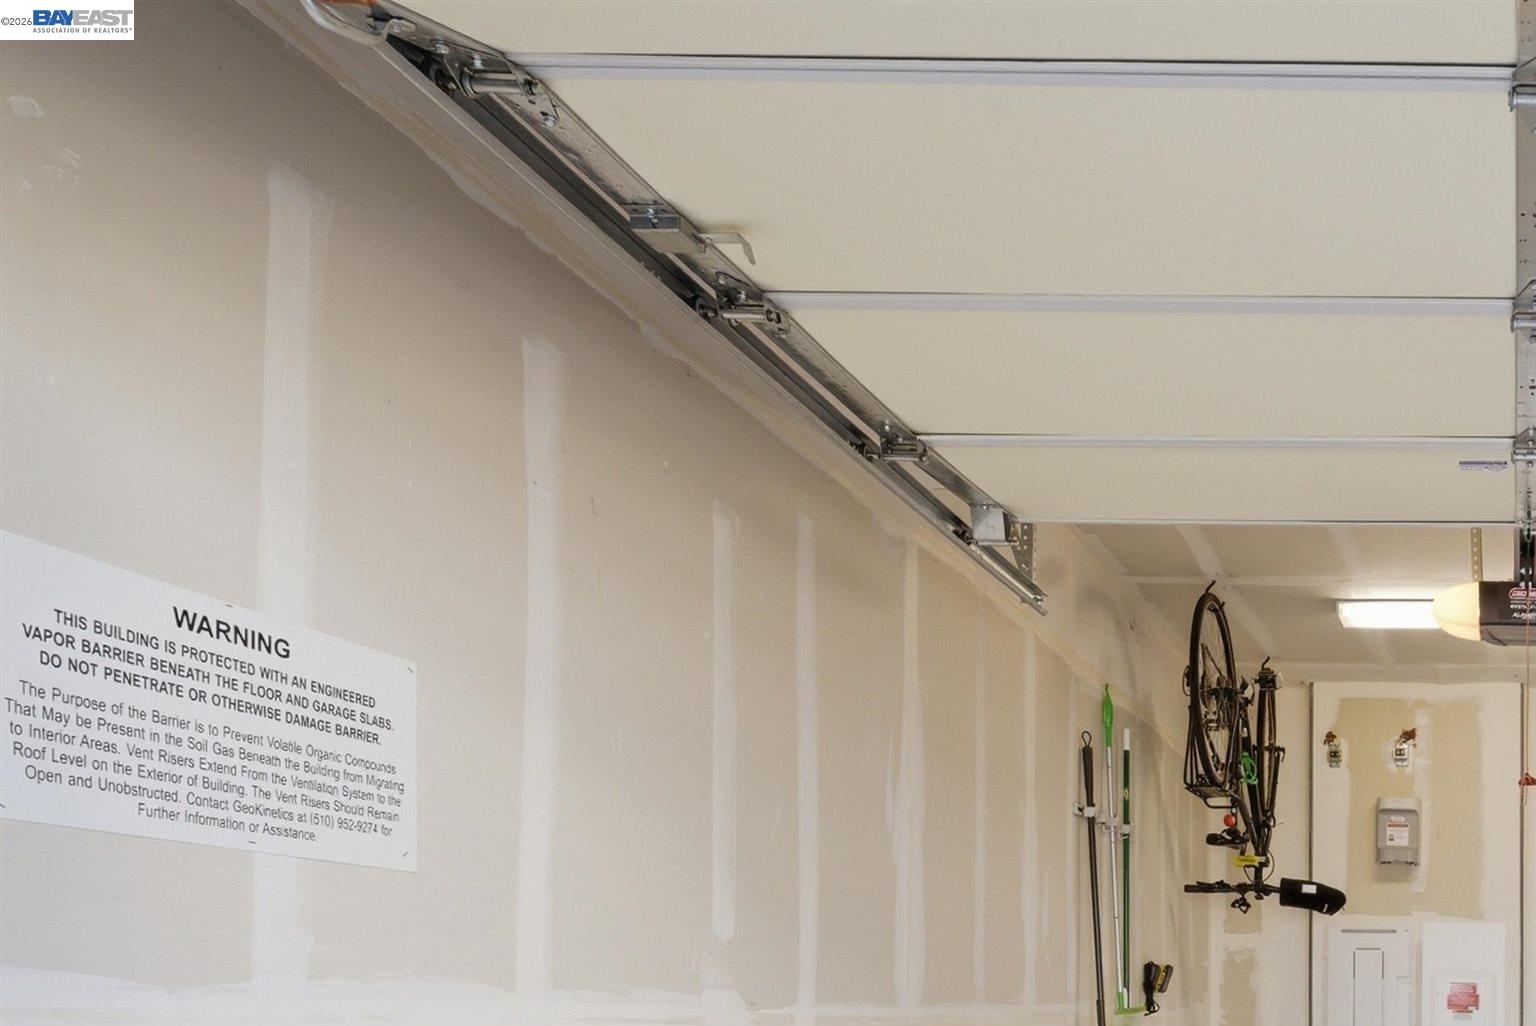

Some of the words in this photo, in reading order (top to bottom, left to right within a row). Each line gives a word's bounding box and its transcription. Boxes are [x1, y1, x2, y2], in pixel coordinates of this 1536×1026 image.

[54, 608, 88, 630] THIS
[94, 620, 160, 650] BUILDING
[164, 640, 176, 654] IS
[181, 645, 255, 676] PROTECTED
[260, 666, 288, 684] WITH
[292, 676, 307, 689] AN
[311, 680, 376, 708] ENGINEERED
[173, 606, 290, 658] WARNING
[22, 623, 76, 650] VAPOR
[82, 639, 144, 667] BARRIER
[150, 657, 210, 684] BENEATH
[215, 674, 238, 691] THE
[243, 682, 282, 701] FLOOR
[286, 694, 309, 710] AND
[312, 700, 356, 722] GARAGE
[360, 709, 394, 731] SLABS.
[40, 650, 62, 668] DO
[68, 658, 98, 677] NOT
[104, 666, 184, 698] PENETRATE
[188, 688, 207, 704] OR
[212, 694, 281, 721] OTHERWISE
[285, 712, 332, 734] DAMAGE
[5, 697, 36, 717] That
[42, 706, 70, 727] May
[76, 714, 92, 729] be
[98, 718, 146, 740] Present
[150, 728, 160, 743] in
[165, 732, 183, 748] the
[187, 736, 208, 752] Soil
[212, 741, 234, 758] Gas
[239, 747, 281, 768] Beneath
[284, 758, 300, 771] the
[304, 761, 340, 782] Building
[344, 769, 364, 784] from
[366, 774, 404, 795] Migrating
[10, 721, 22, 736] to
[29, 724, 76, 746] Interior
[80, 734, 120, 755] Areas.
[126, 743, 154, 760] Vent
[158, 749, 194, 769] Risers
[200, 758, 236, 776] Extend
[241, 766, 268, 782] From
[272, 772, 287, 786] the
[290, 774, 338, 796] Ventilation
[342, 785, 374, 804] System
[376, 794, 386, 806] to
[388, 794, 402, 808] the
[19, 680, 46, 699] The
[52, 687, 106, 712] Purpose
[111, 703, 124, 716] of
[128, 706, 147, 721] the
[152, 710, 190, 730] Barrier
[195, 718, 204, 734] is
[208, 724, 218, 736] to
[223, 726, 264, 746] Prevent
[267, 736, 302, 755] Volatile
[306, 744, 342, 764] Organic
[344, 753, 396, 775] Compounds
[13, 741, 46, 760] Roof
[52, 748, 87, 768] Level
[92, 758, 108, 771] on
[113, 760, 132, 776] the
[138, 764, 183, 785] Exterior
[187, 774, 199, 787] of
[202, 776, 248, 800] Building.
[252, 785, 272, 800] The
[276, 789, 298, 804] Vent
[301, 794, 330, 811] Risers
[334, 799, 364, 816] Should
[368, 806, 400, 822] Remain
[25, 764, 62, 785] Open
[68, 774, 92, 789] and
[99, 778, 182, 804] Unobstructed.
[186, 792, 229, 812] Contact
[233, 799, 294, 822] GeoKinetics
[297, 812, 307, 823] at
[381, 826, 393, 836] for
[138, 803, 181, 821] Further
[184, 810, 245, 832] Information
[249, 822, 260, 833] or
[262, 824, 318, 843] Assistance.
